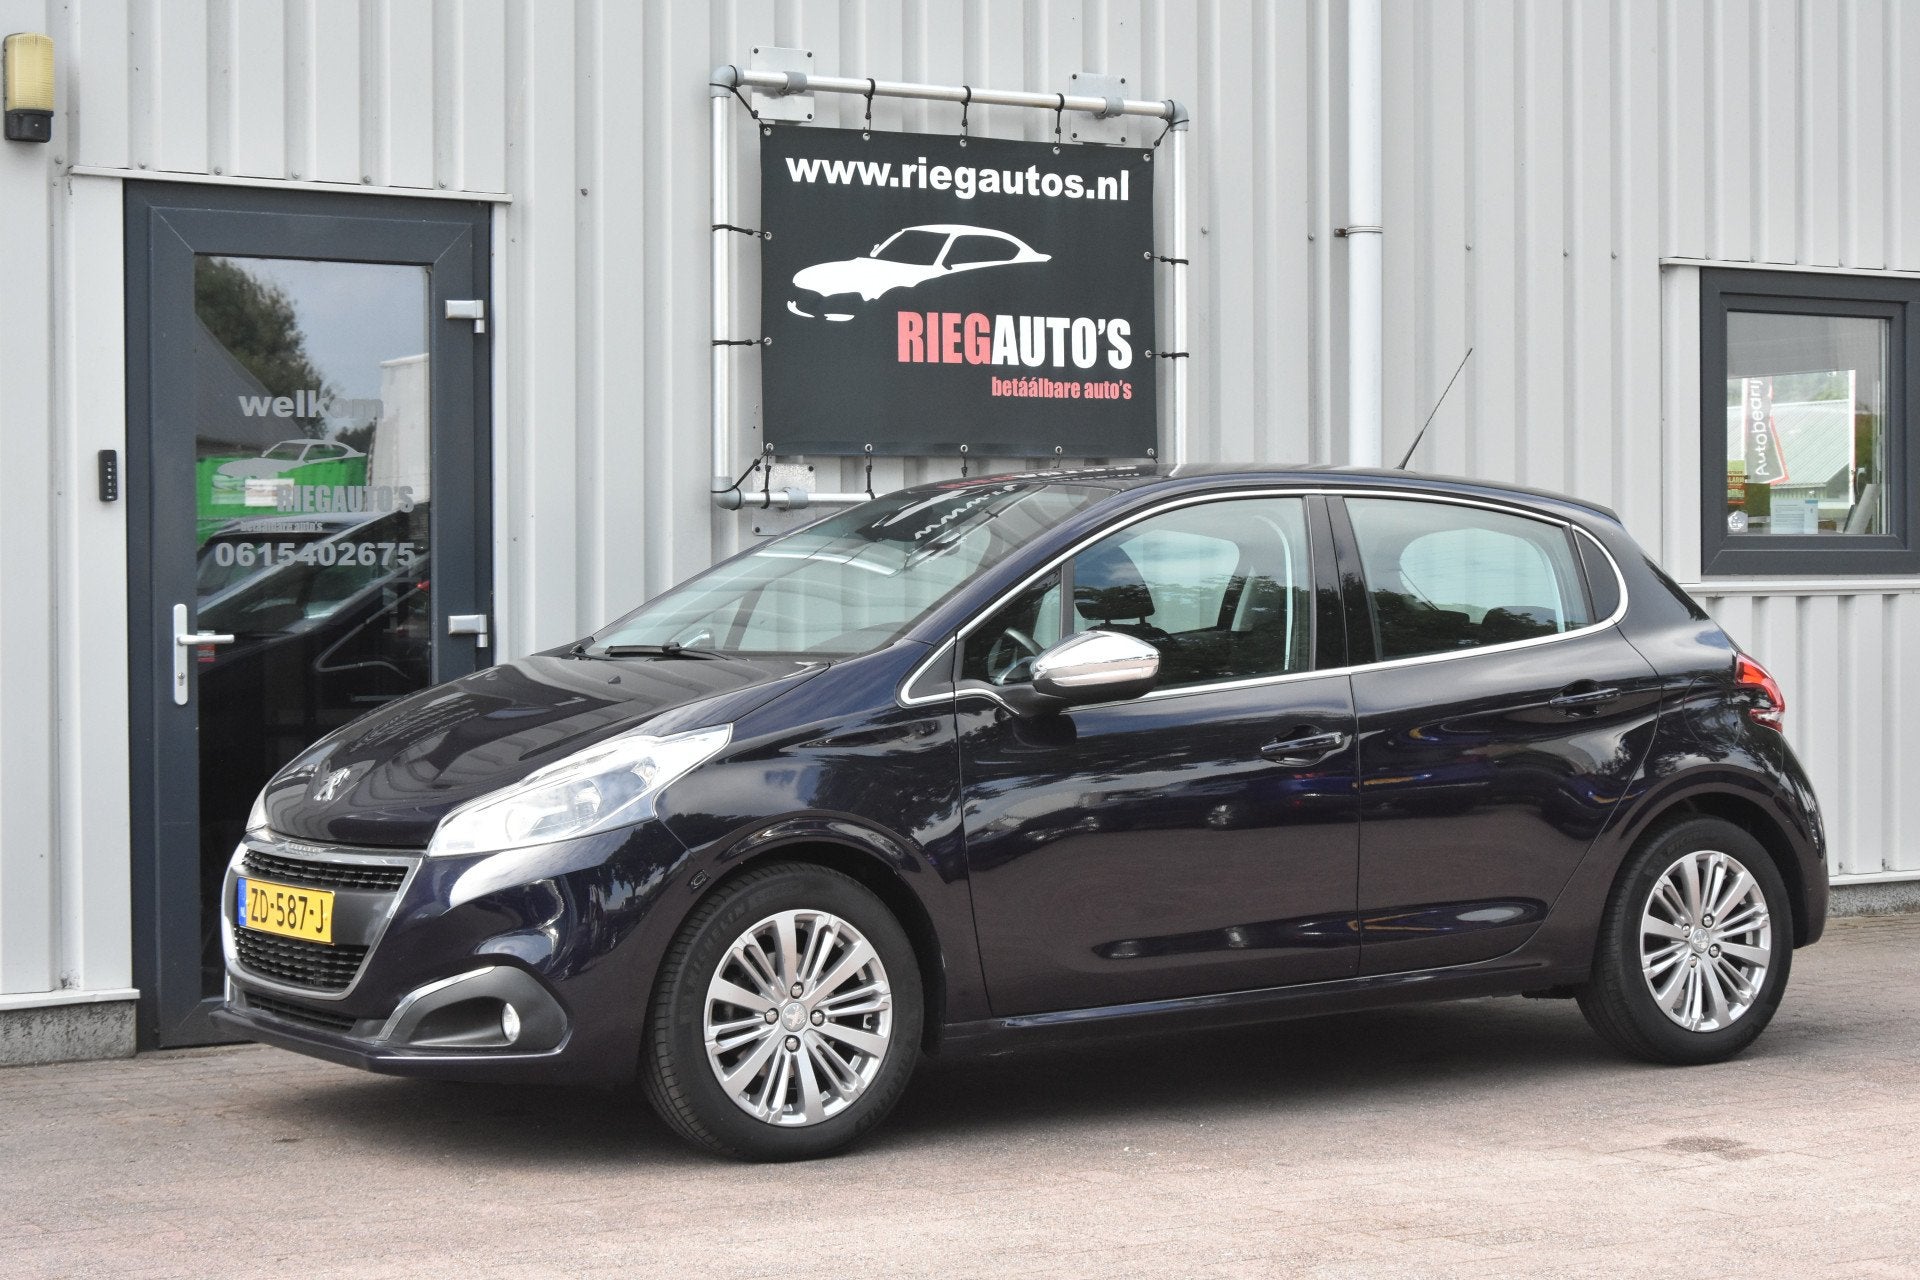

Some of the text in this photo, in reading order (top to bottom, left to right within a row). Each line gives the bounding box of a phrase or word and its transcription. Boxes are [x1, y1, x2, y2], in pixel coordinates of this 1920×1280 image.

[785, 156, 1129, 200] www.riegautos.nl
[897, 311, 1133, 369] RIEGAUTO'S
[991, 376, 1132, 400] betáálbare auto's
[238, 389, 384, 419] welkom
[276, 484, 415, 513] RIEGAUTO'S
[215, 542, 416, 567] 0615402675
[251, 888, 324, 933] ZD-587-J
